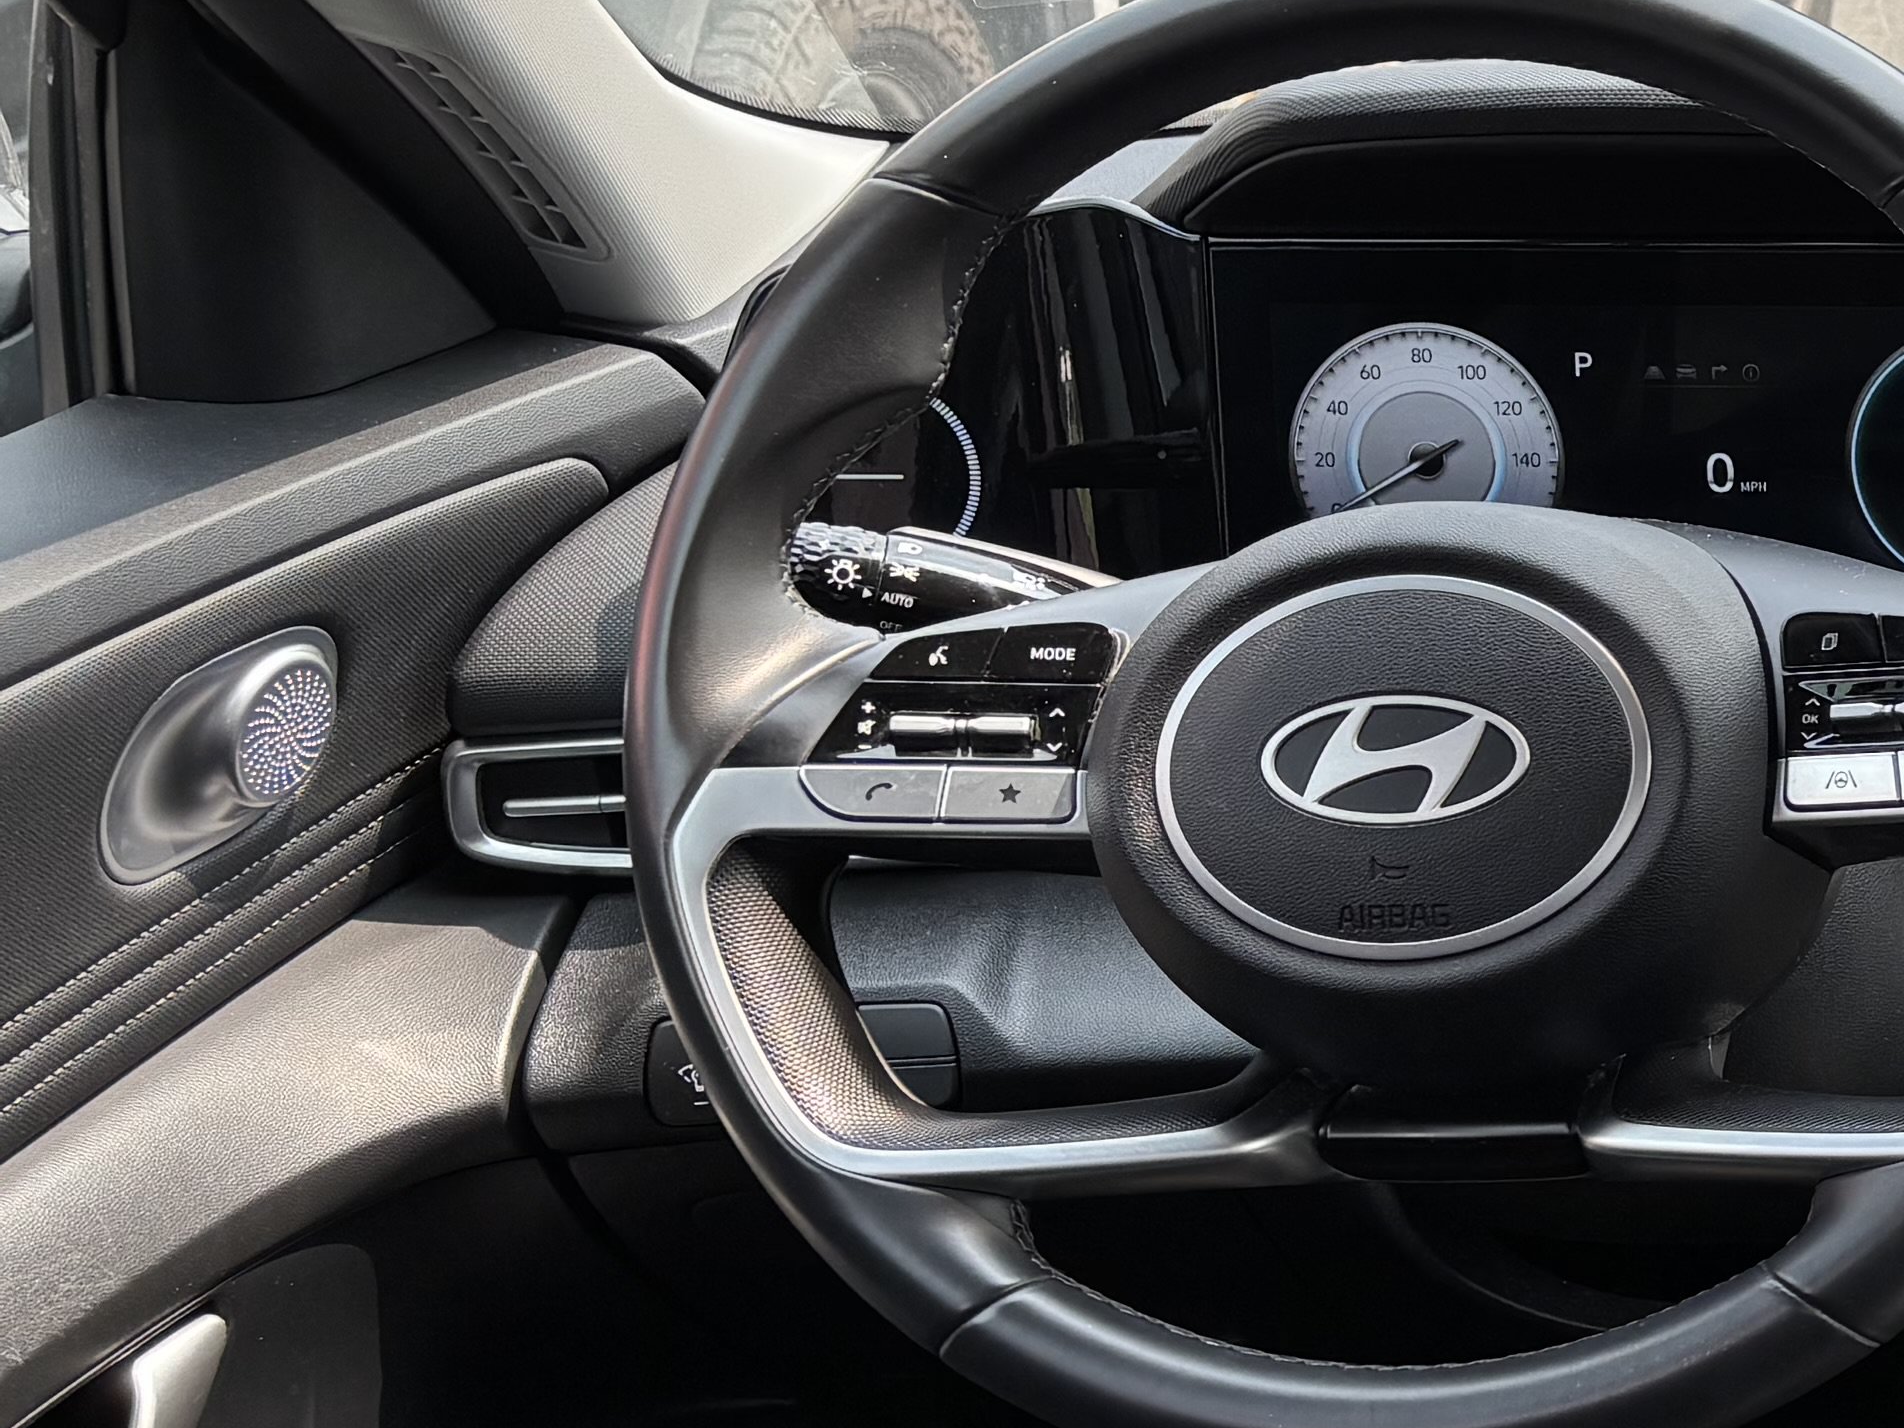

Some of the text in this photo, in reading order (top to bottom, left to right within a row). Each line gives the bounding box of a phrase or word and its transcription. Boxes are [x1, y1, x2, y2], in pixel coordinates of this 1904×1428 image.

[1410, 347, 1433, 364] 80
[1359, 364, 1382, 381] 60
[1457, 364, 1487, 381] 100
[1574, 352, 1593, 377] P
[1326, 399, 1349, 416] 40
[1493, 400, 1523, 417] 120
[1314, 451, 1336, 468] 20
[1511, 452, 1541, 469] 140
[1705, 452, 1768, 494] 0 MPH
[880, 590, 915, 610] AUTO
[1029, 646, 1077, 663] MODE
[1801, 713, 1820, 725] OK
[1338, 903, 1452, 931] AIRBAG
